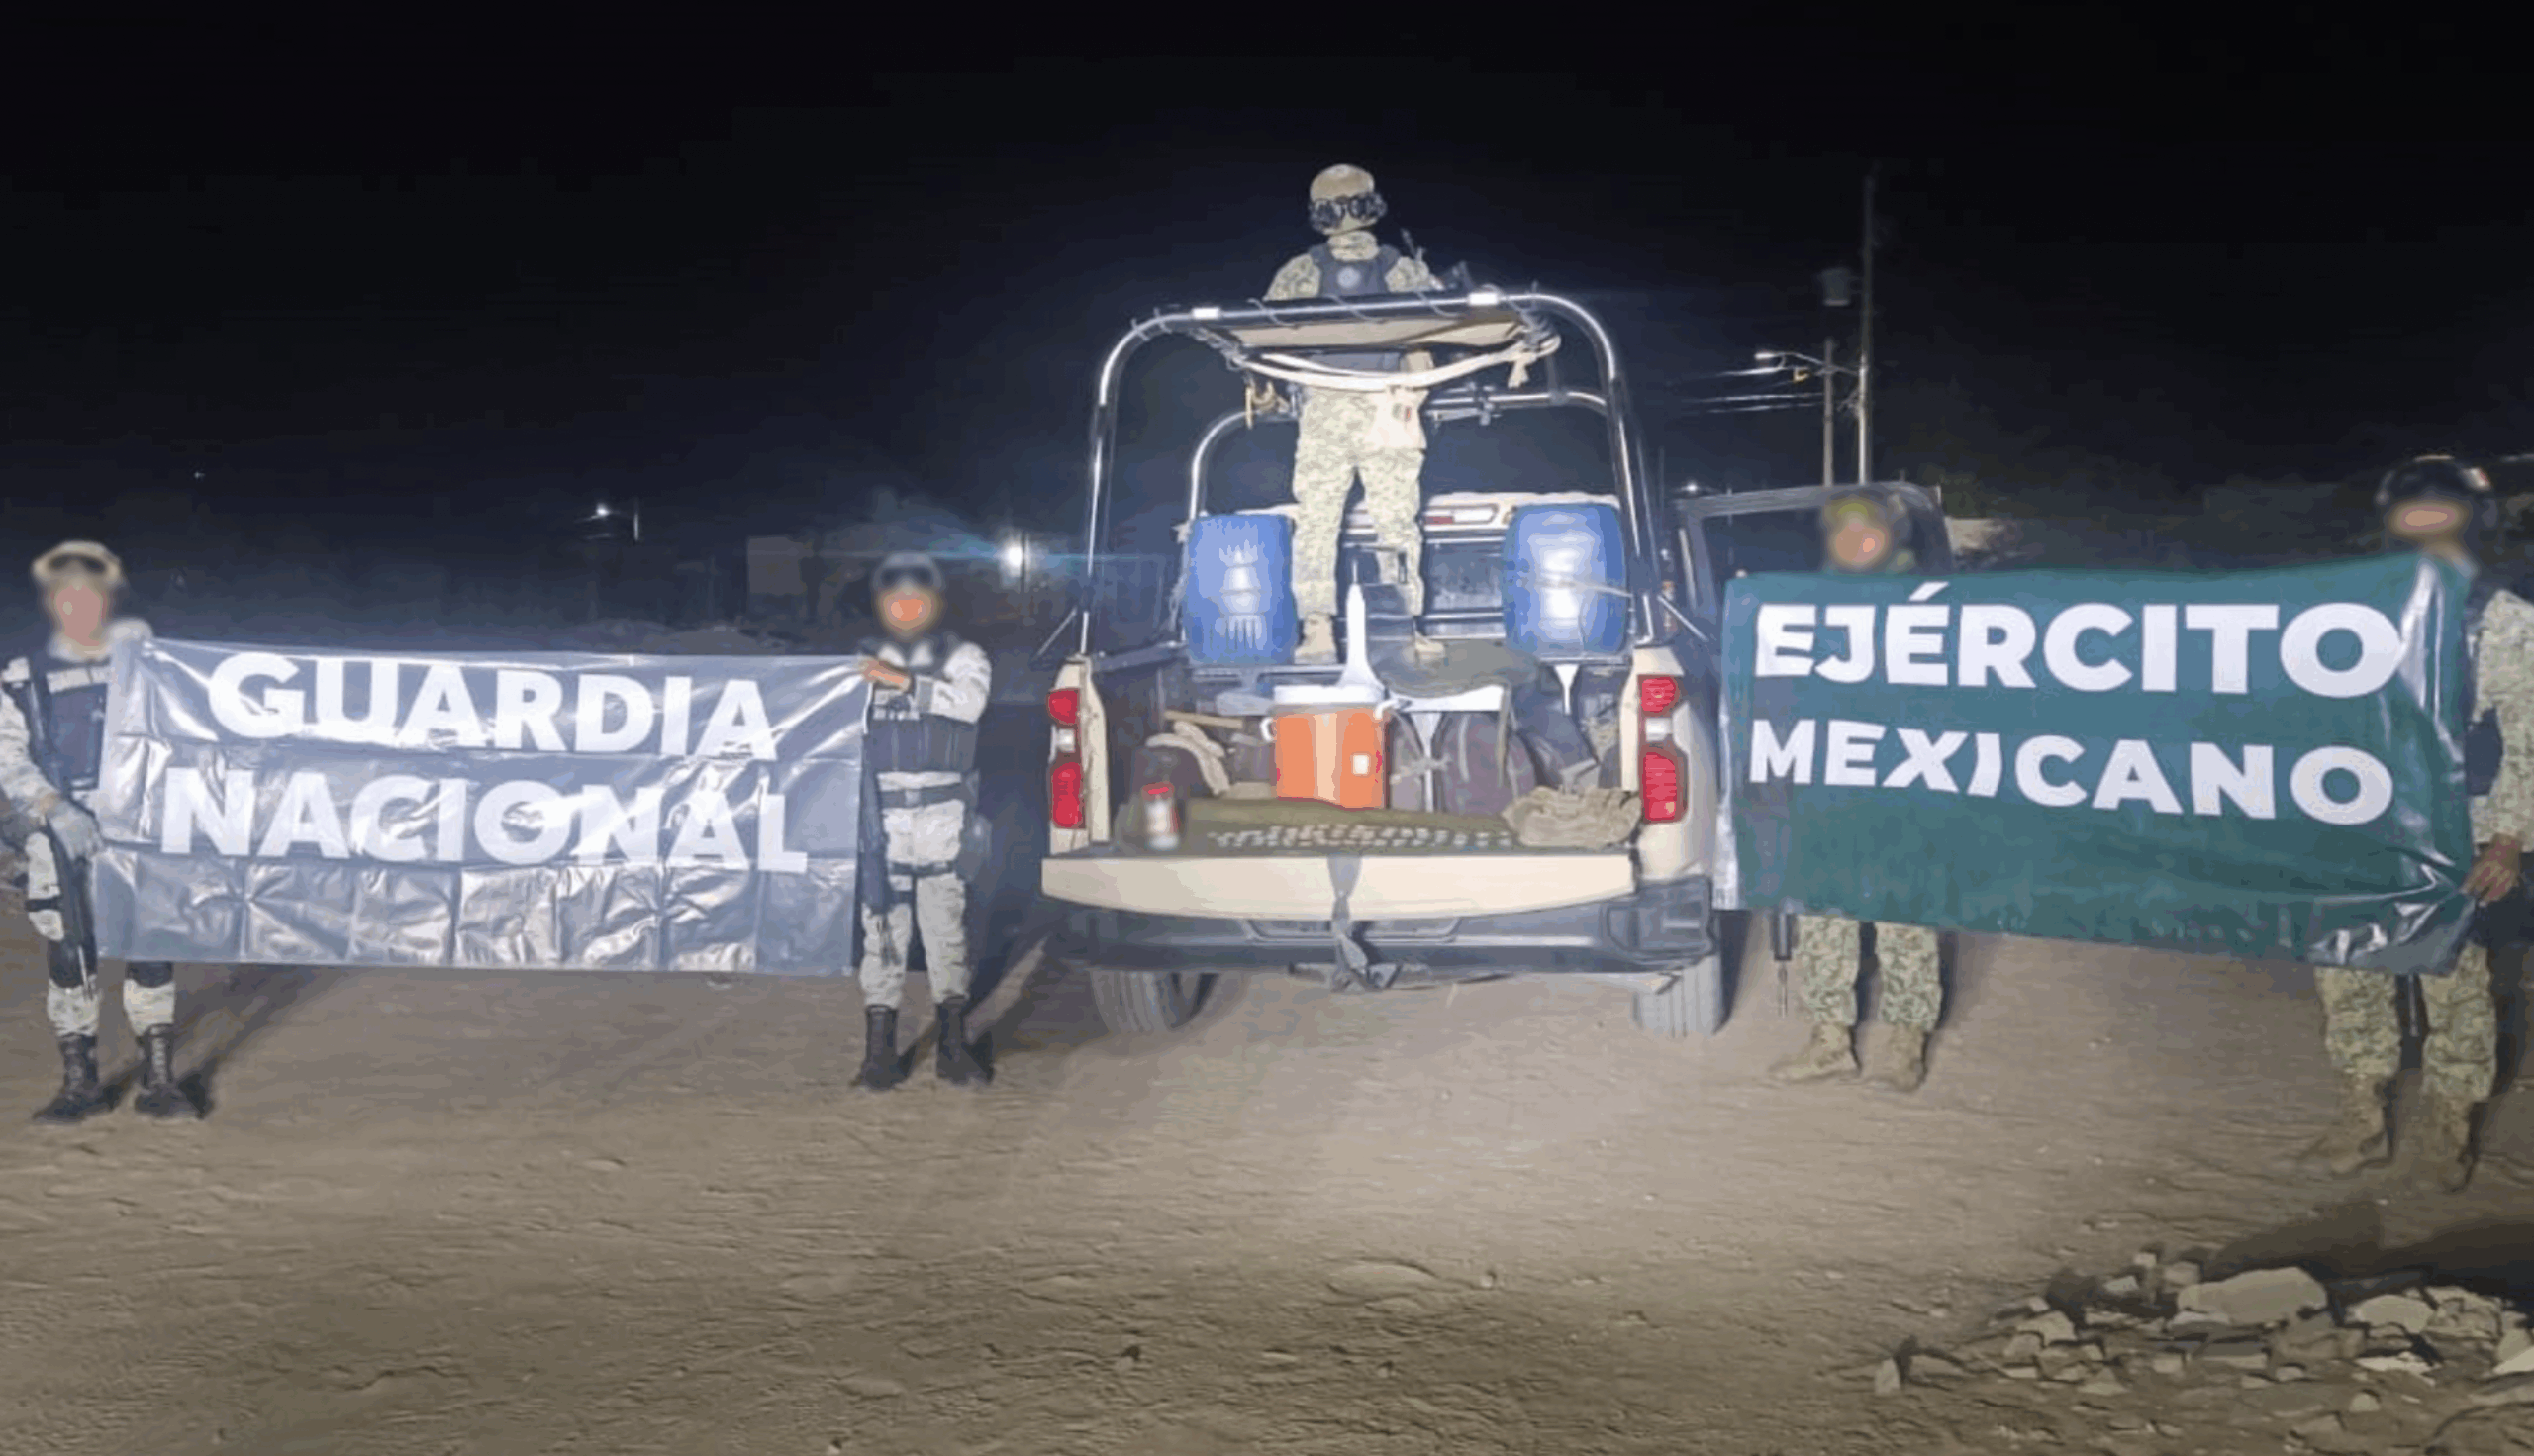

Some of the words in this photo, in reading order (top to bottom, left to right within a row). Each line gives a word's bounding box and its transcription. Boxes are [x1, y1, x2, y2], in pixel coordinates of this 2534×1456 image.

[1755, 582, 2402, 698] EJÉRCITO
[208, 652, 778, 761] GUARDIA
[160, 767, 808, 873] NACIONAL
[1749, 720, 2393, 825] MEXICANO
